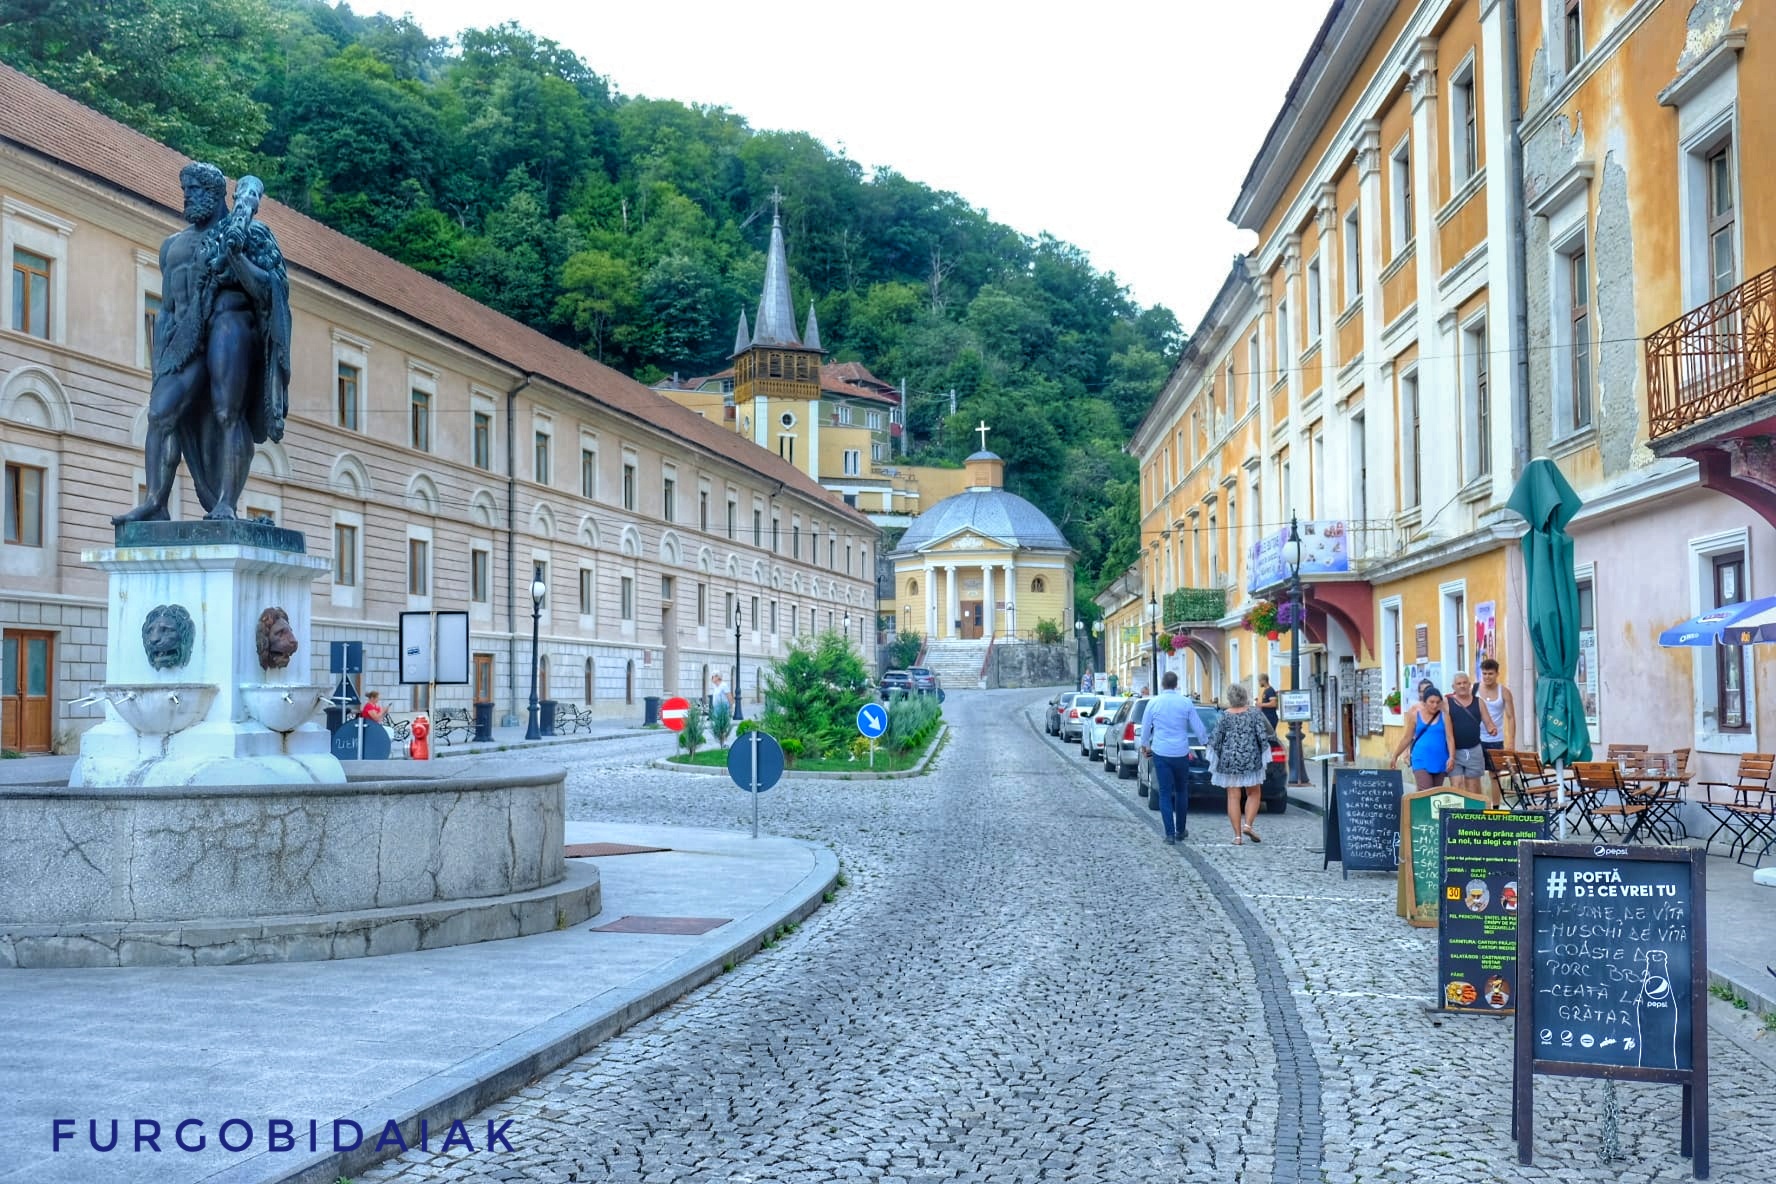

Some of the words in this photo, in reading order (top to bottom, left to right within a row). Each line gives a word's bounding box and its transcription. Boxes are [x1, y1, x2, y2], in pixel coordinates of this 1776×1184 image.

[1502, 815, 1545, 823] HERCULES
[1458, 829, 1480, 837] Meniu
[1482, 829, 1492, 837] de
[1483, 838, 1501, 847] alegi
[1574, 868, 1622, 883] POFTĂ
[1448, 888, 1459, 897] 30
[1574, 886, 1594, 897] DE
[1598, 886, 1618, 896] CE
[1620, 885, 1653, 897] VREI
[1656, 884, 1676, 896] TU
[1546, 960, 1592, 976] PORC
[1620, 990, 1644, 1006] LA
